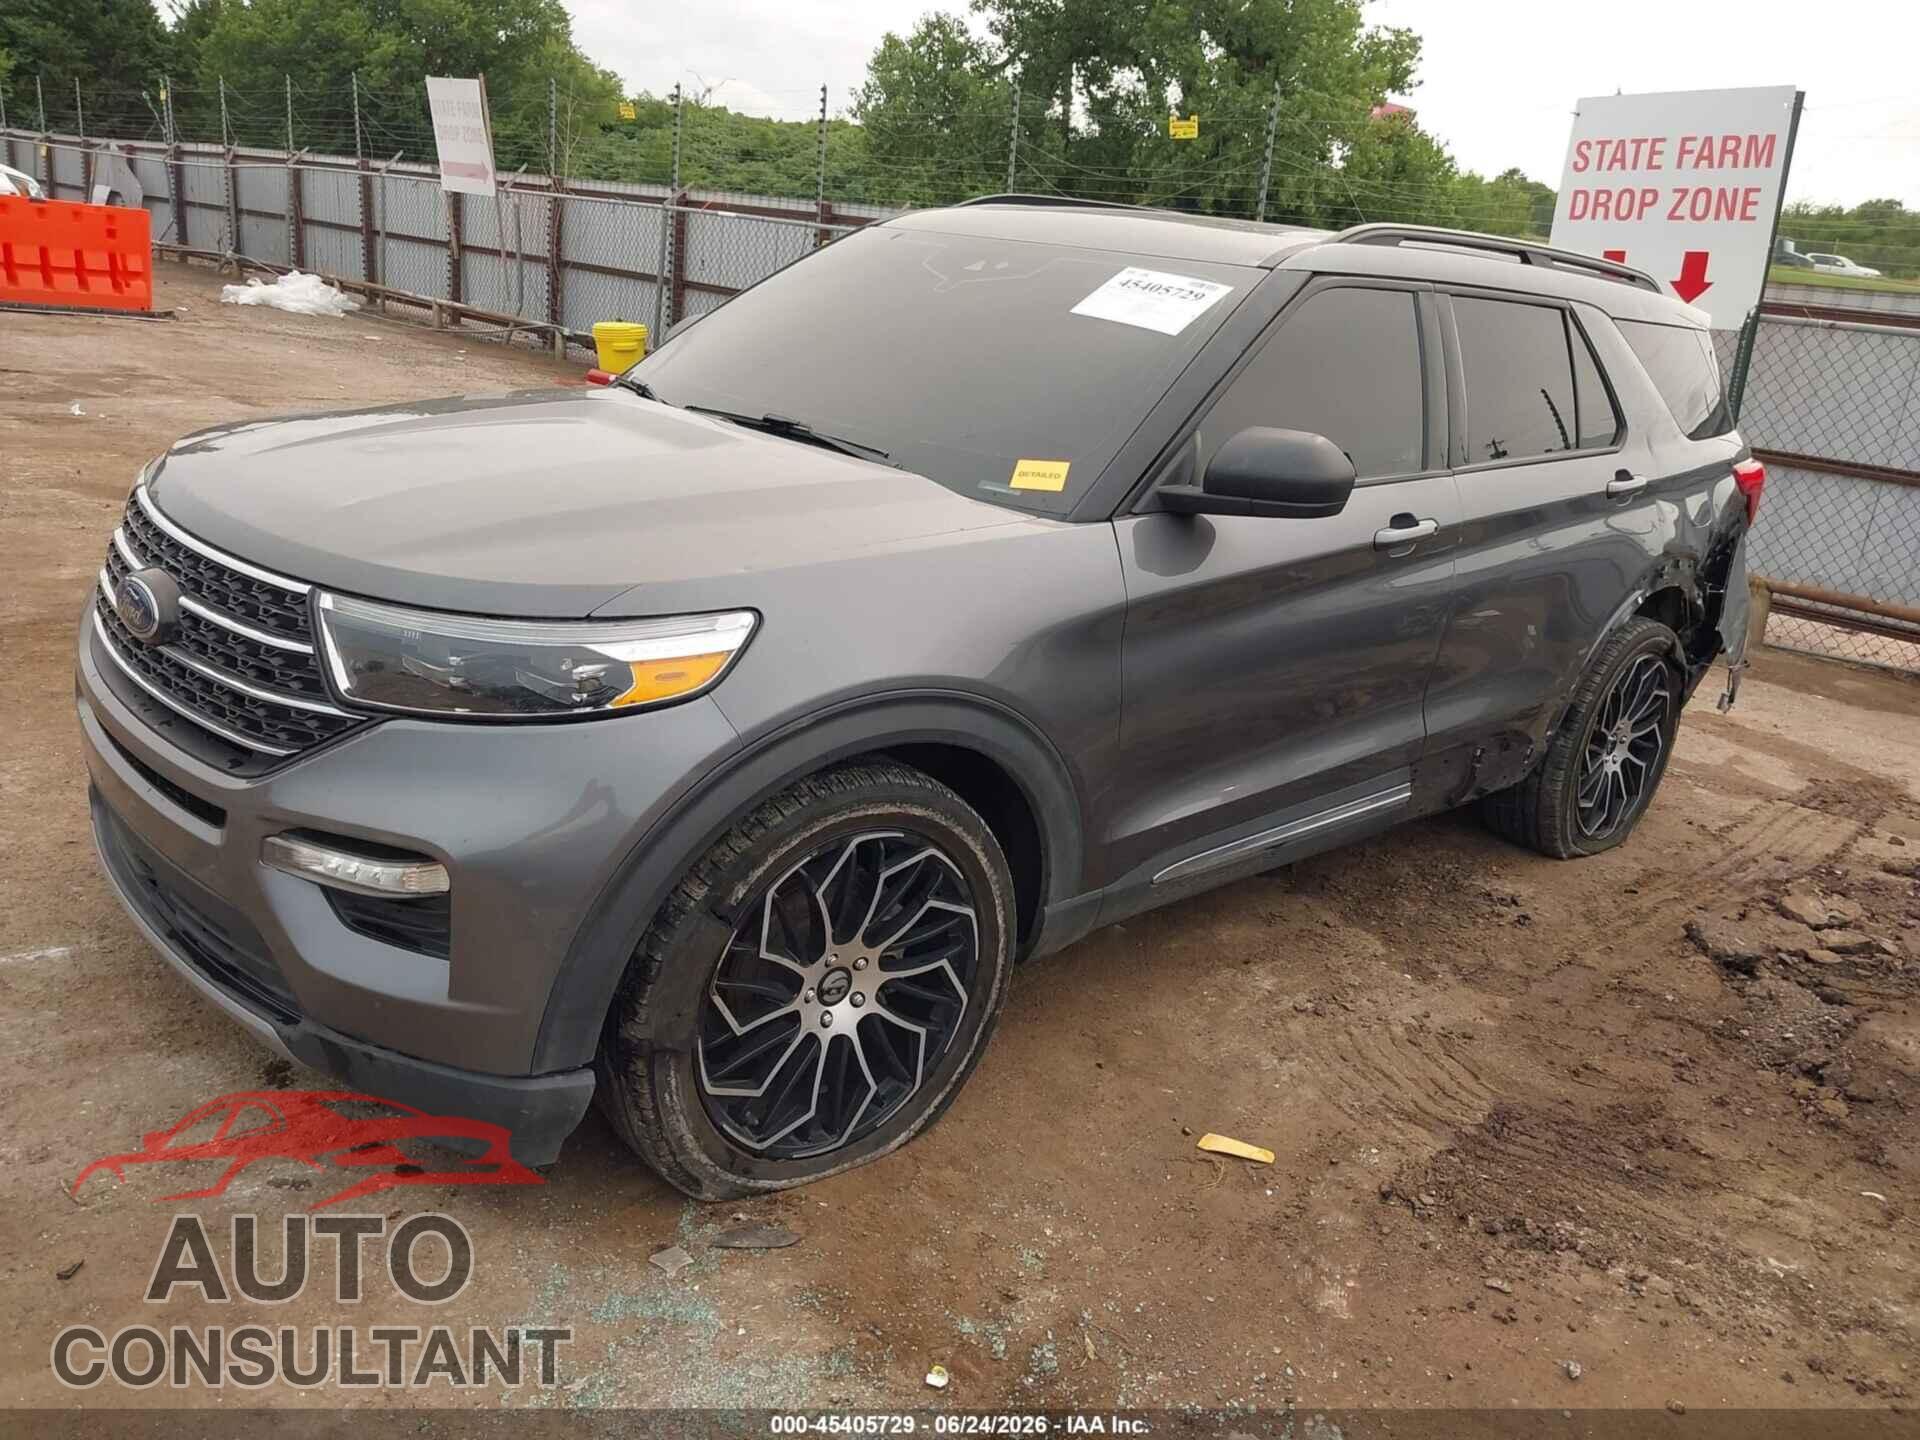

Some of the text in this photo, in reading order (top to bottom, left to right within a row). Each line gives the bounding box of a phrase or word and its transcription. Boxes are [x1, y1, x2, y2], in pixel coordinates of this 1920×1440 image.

[1572, 134, 1776, 172] STATE FARM
[1568, 186, 1762, 222] DROP ZONE
[1119, 278, 1206, 301] 45405729
[1017, 470, 1062, 480] DETAILED
